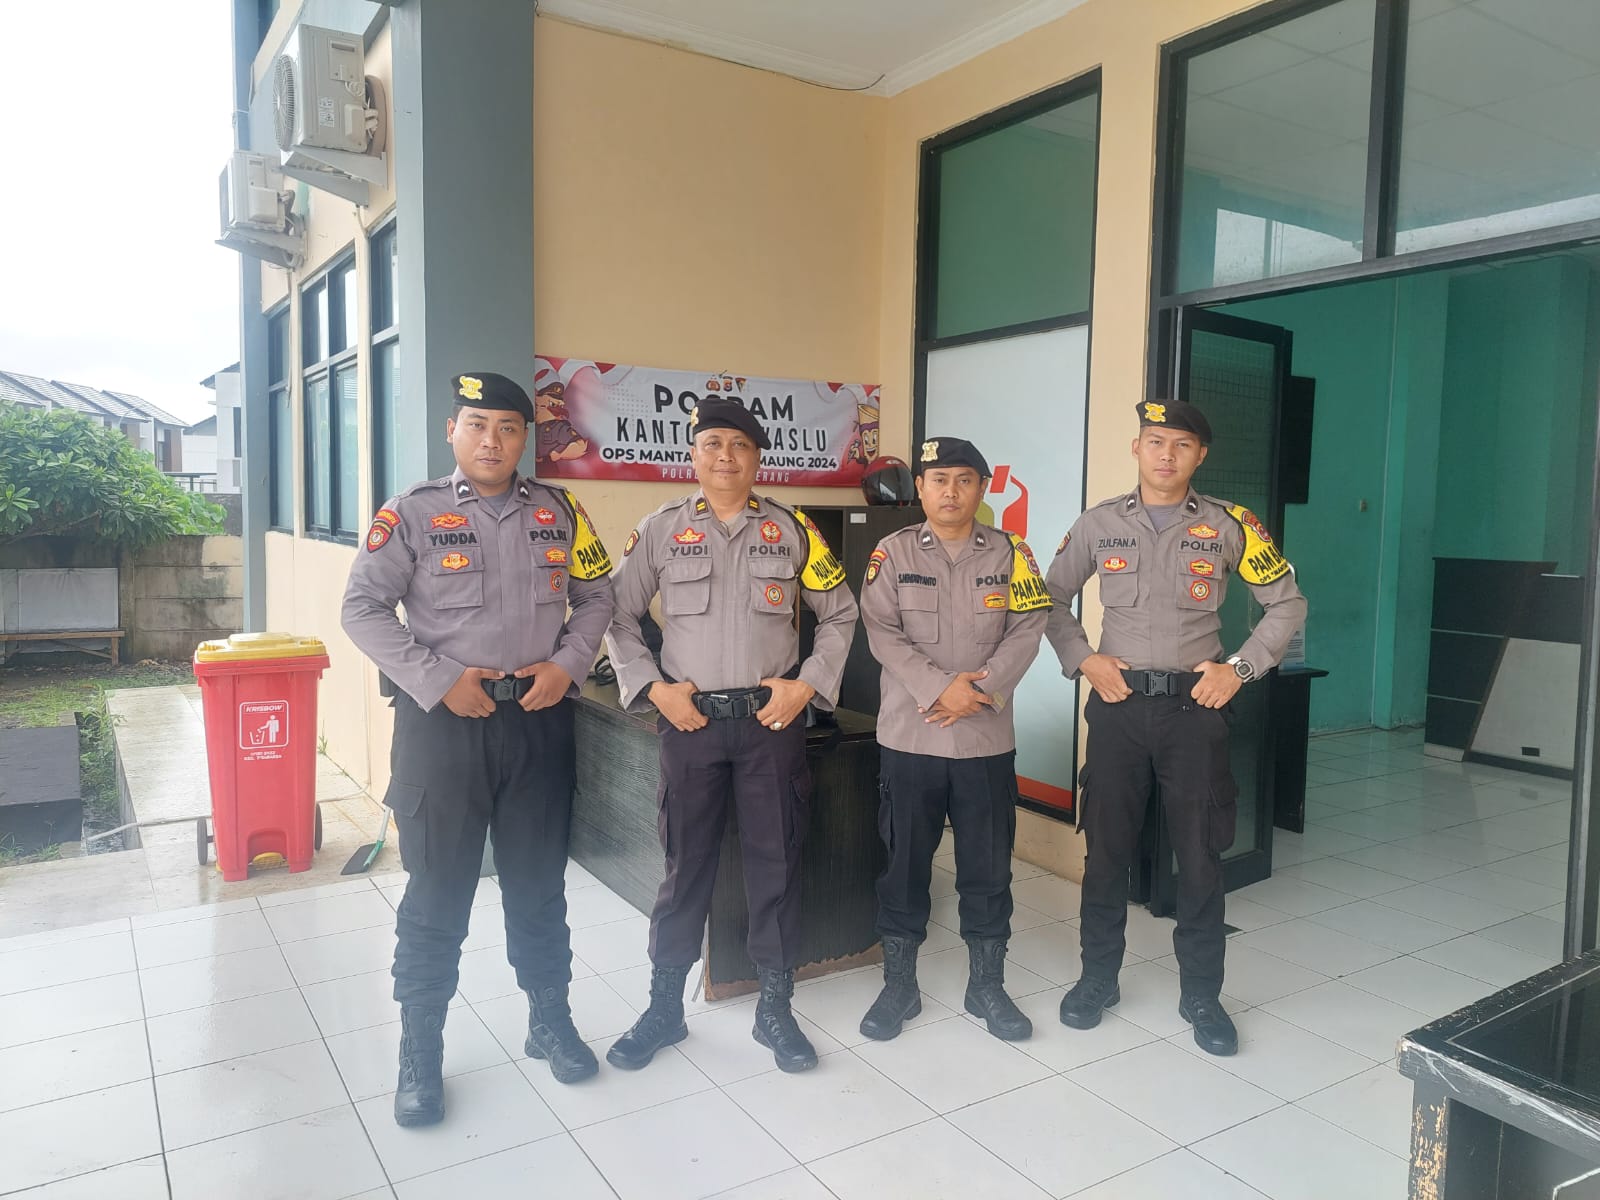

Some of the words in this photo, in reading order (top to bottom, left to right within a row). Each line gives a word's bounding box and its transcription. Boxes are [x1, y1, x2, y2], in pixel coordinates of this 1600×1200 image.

[655, 383, 793, 421] POAM
[617, 416, 694, 446] KANTO
[602, 447, 635, 460] OPS
[639, 449, 693, 463] MANTA
[807, 457, 837, 469] 2024
[662, 467, 698, 479] POLR
[429, 532, 478, 546] YUDDA
[529, 529, 567, 542] POLRI
[1098, 537, 1137, 549] ZULFAN.A
[1180, 540, 1223, 553] POLRI
[576, 542, 602, 571] PAM
[670, 545, 708, 557] YUDI
[750, 545, 790, 557] POLRI
[1247, 549, 1277, 577] PAM
[976, 574, 1008, 587] POLRI
[1010, 578, 1036, 603] PAM
[1016, 601, 1028, 610] OPS
[246, 704, 283, 713] KRISBOW
